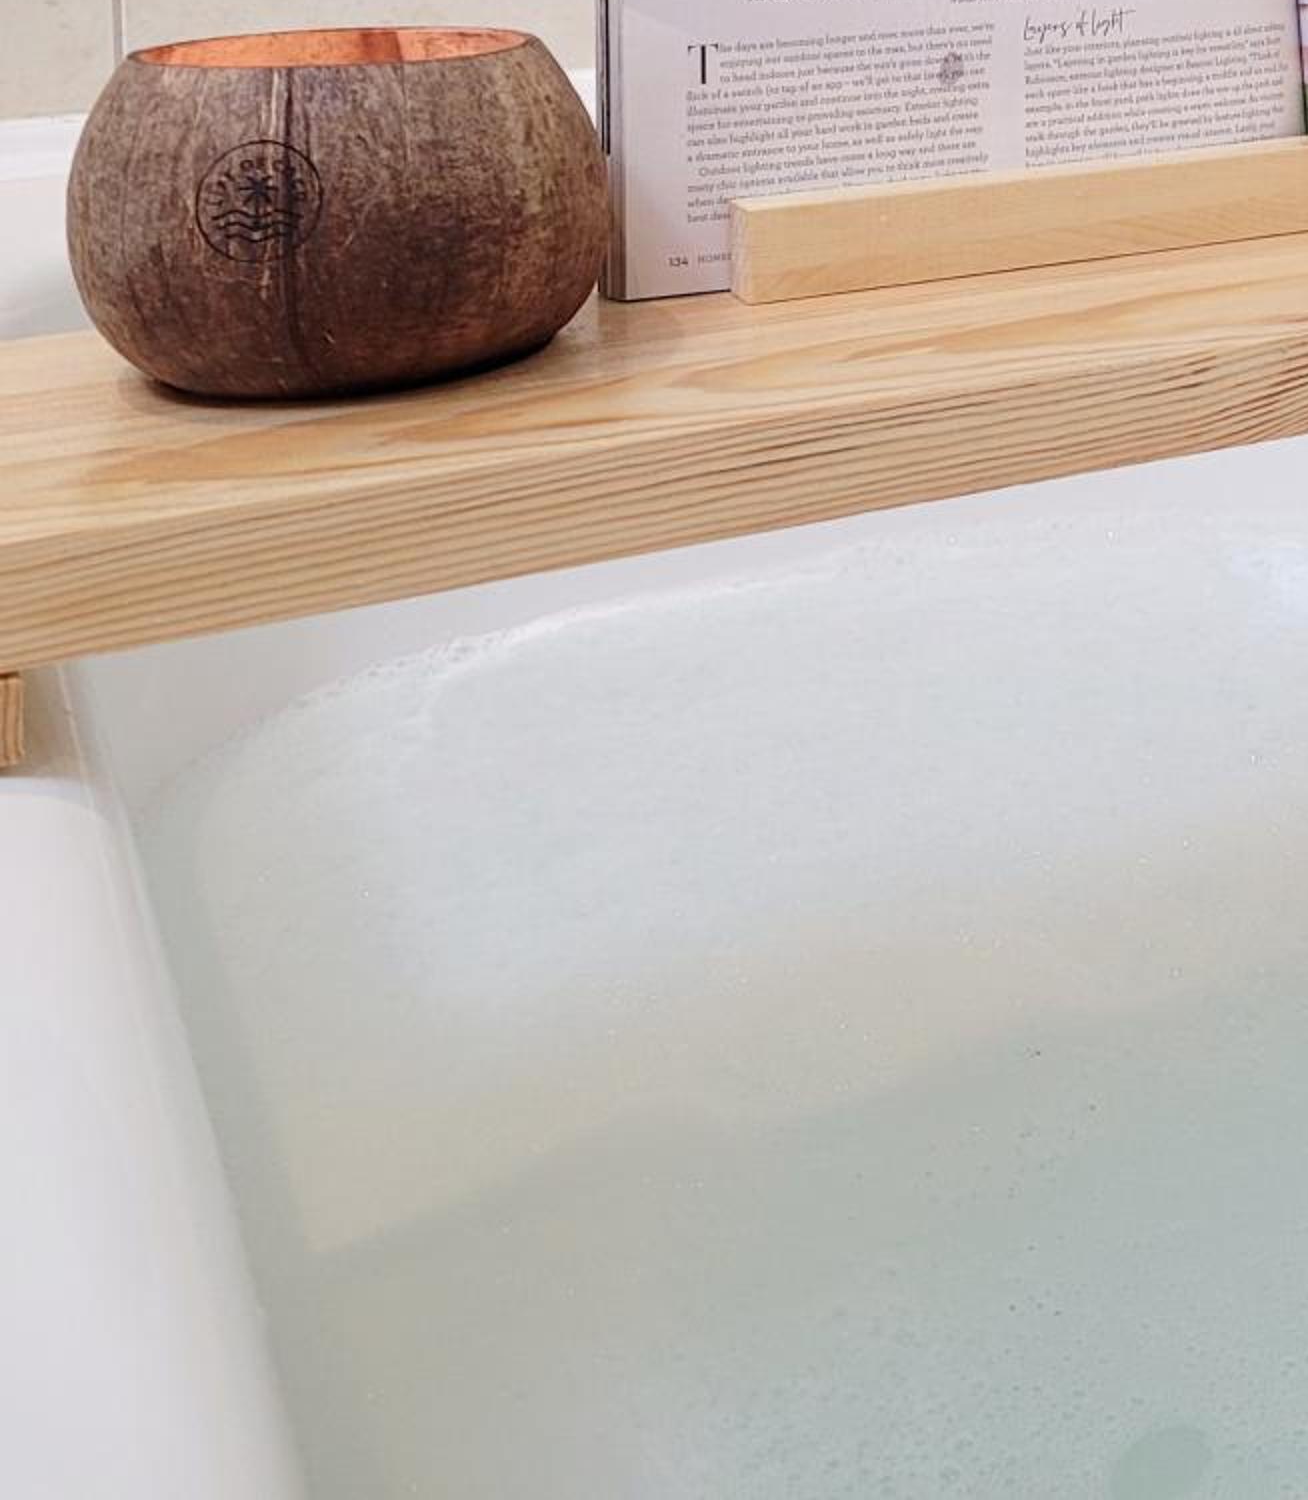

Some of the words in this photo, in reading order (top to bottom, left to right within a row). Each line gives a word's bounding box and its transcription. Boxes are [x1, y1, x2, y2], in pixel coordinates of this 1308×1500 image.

[1023, 15, 1070, 44] Layers
[1075, 9, 1088, 37] of
[1091, 8, 1136, 37] light
